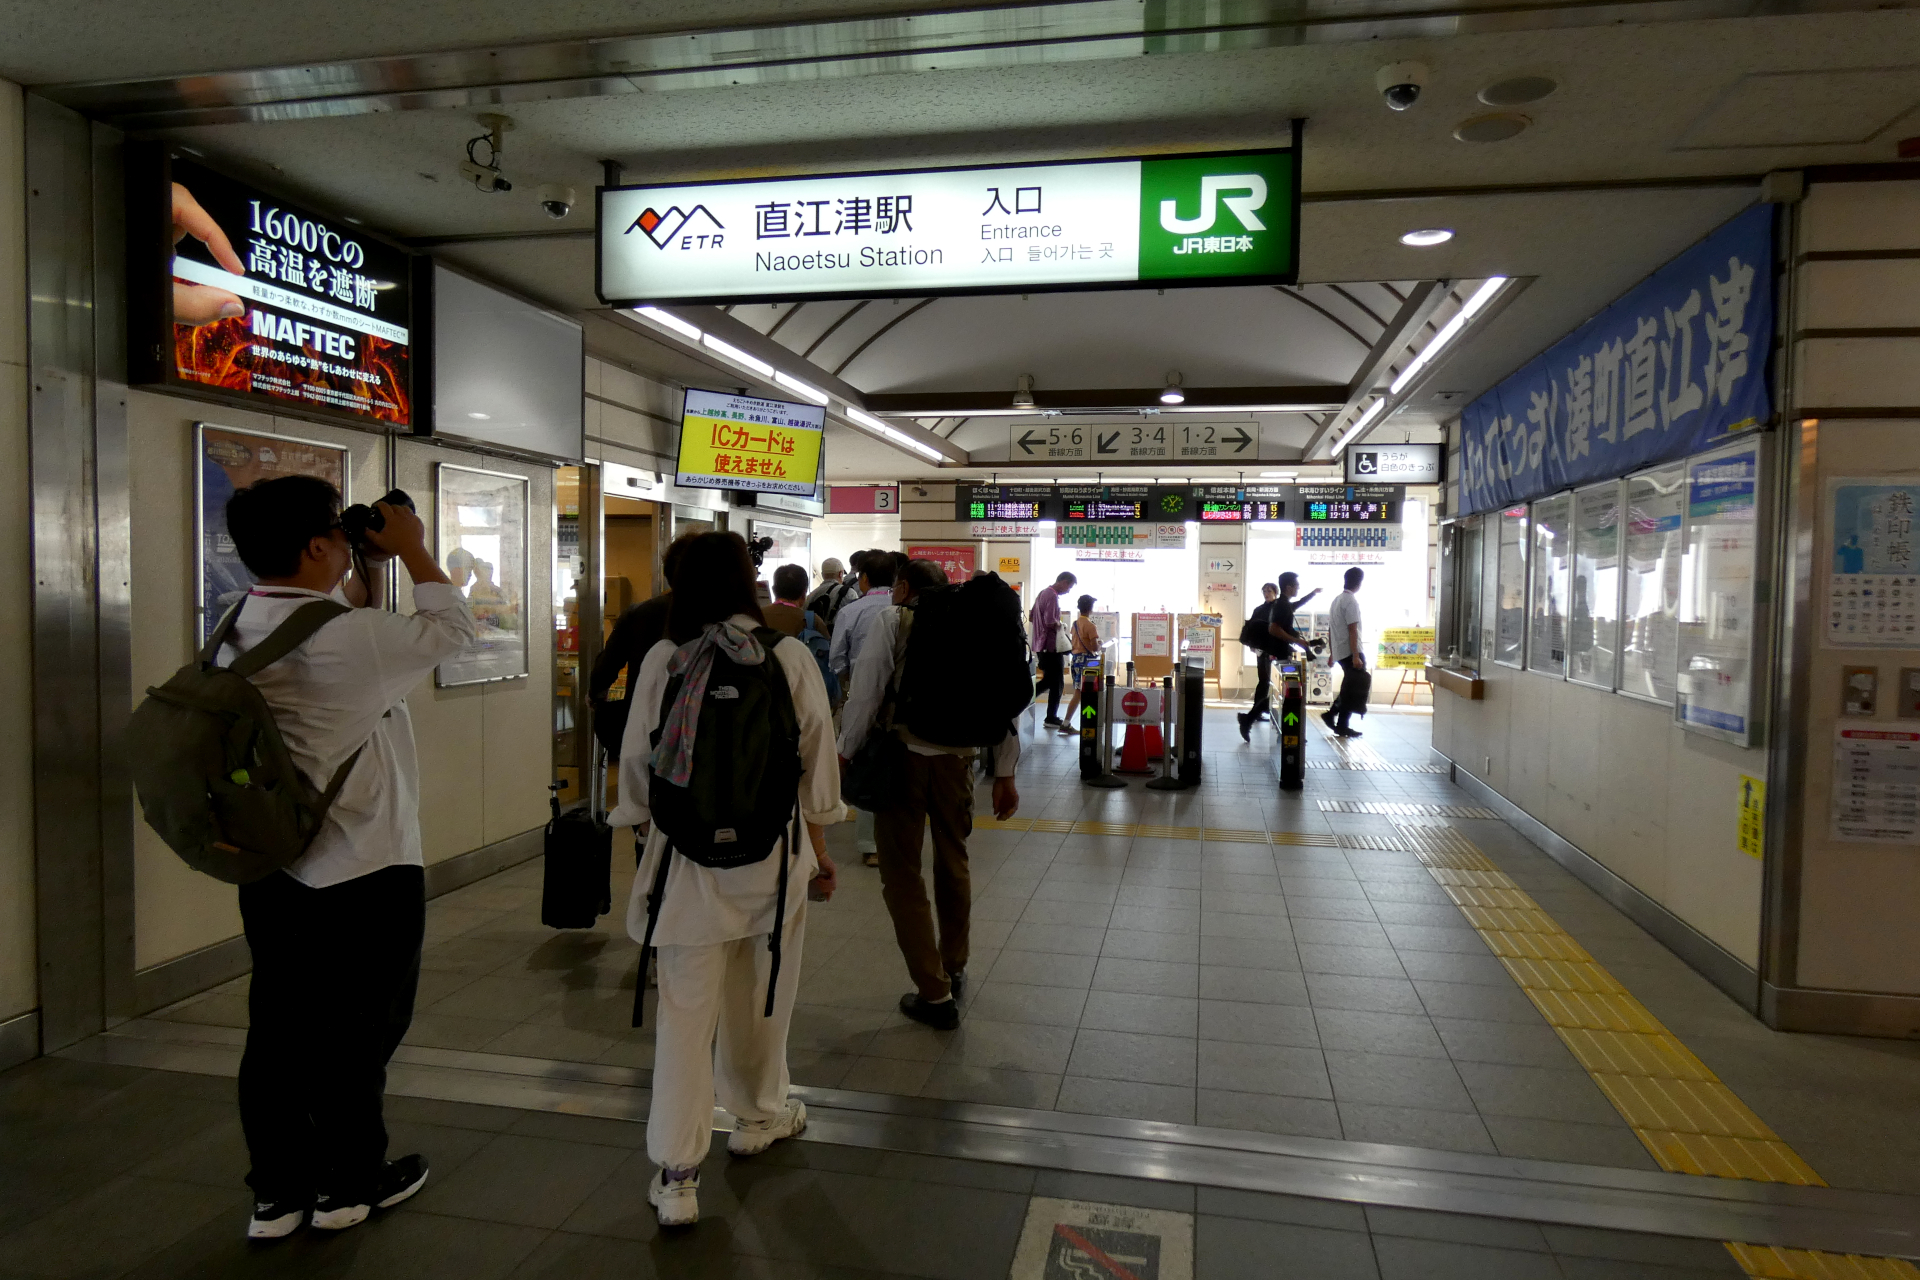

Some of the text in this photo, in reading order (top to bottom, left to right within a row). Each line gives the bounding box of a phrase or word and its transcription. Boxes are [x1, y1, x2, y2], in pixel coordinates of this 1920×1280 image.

[981, 187, 1043, 216] 入口
[1160, 173, 1268, 236] JR
[754, 194, 914, 239] 直江津駅
[249, 199, 365, 269] 1600℃の
[681, 232, 724, 250] ETR
[980, 221, 1062, 240] Entrance
[981, 246, 1014, 264] 入口
[1027, 240, 1115, 263] 들어가는 곳
[1173, 236, 1254, 255] JR東日本
[754, 243, 944, 273] Naoetsu Station
[248, 237, 379, 313] 高温を遮断
[252, 309, 356, 360] MAFTEC
[1565, 256, 1756, 463] 湊町直江津
[711, 423, 795, 455] ICカードは
[1048, 447, 1083, 458] 番線方面
[1130, 446, 1166, 457] 番線方面
[1181, 446, 1217, 457] 番線方面
[1382, 452, 1409, 461] うらが
[714, 452, 787, 478] 使えません
[1381, 462, 1435, 472] 白色のきっぷ
[879, 492, 889, 508] 3
[934, 560, 971, 573] 寿し
